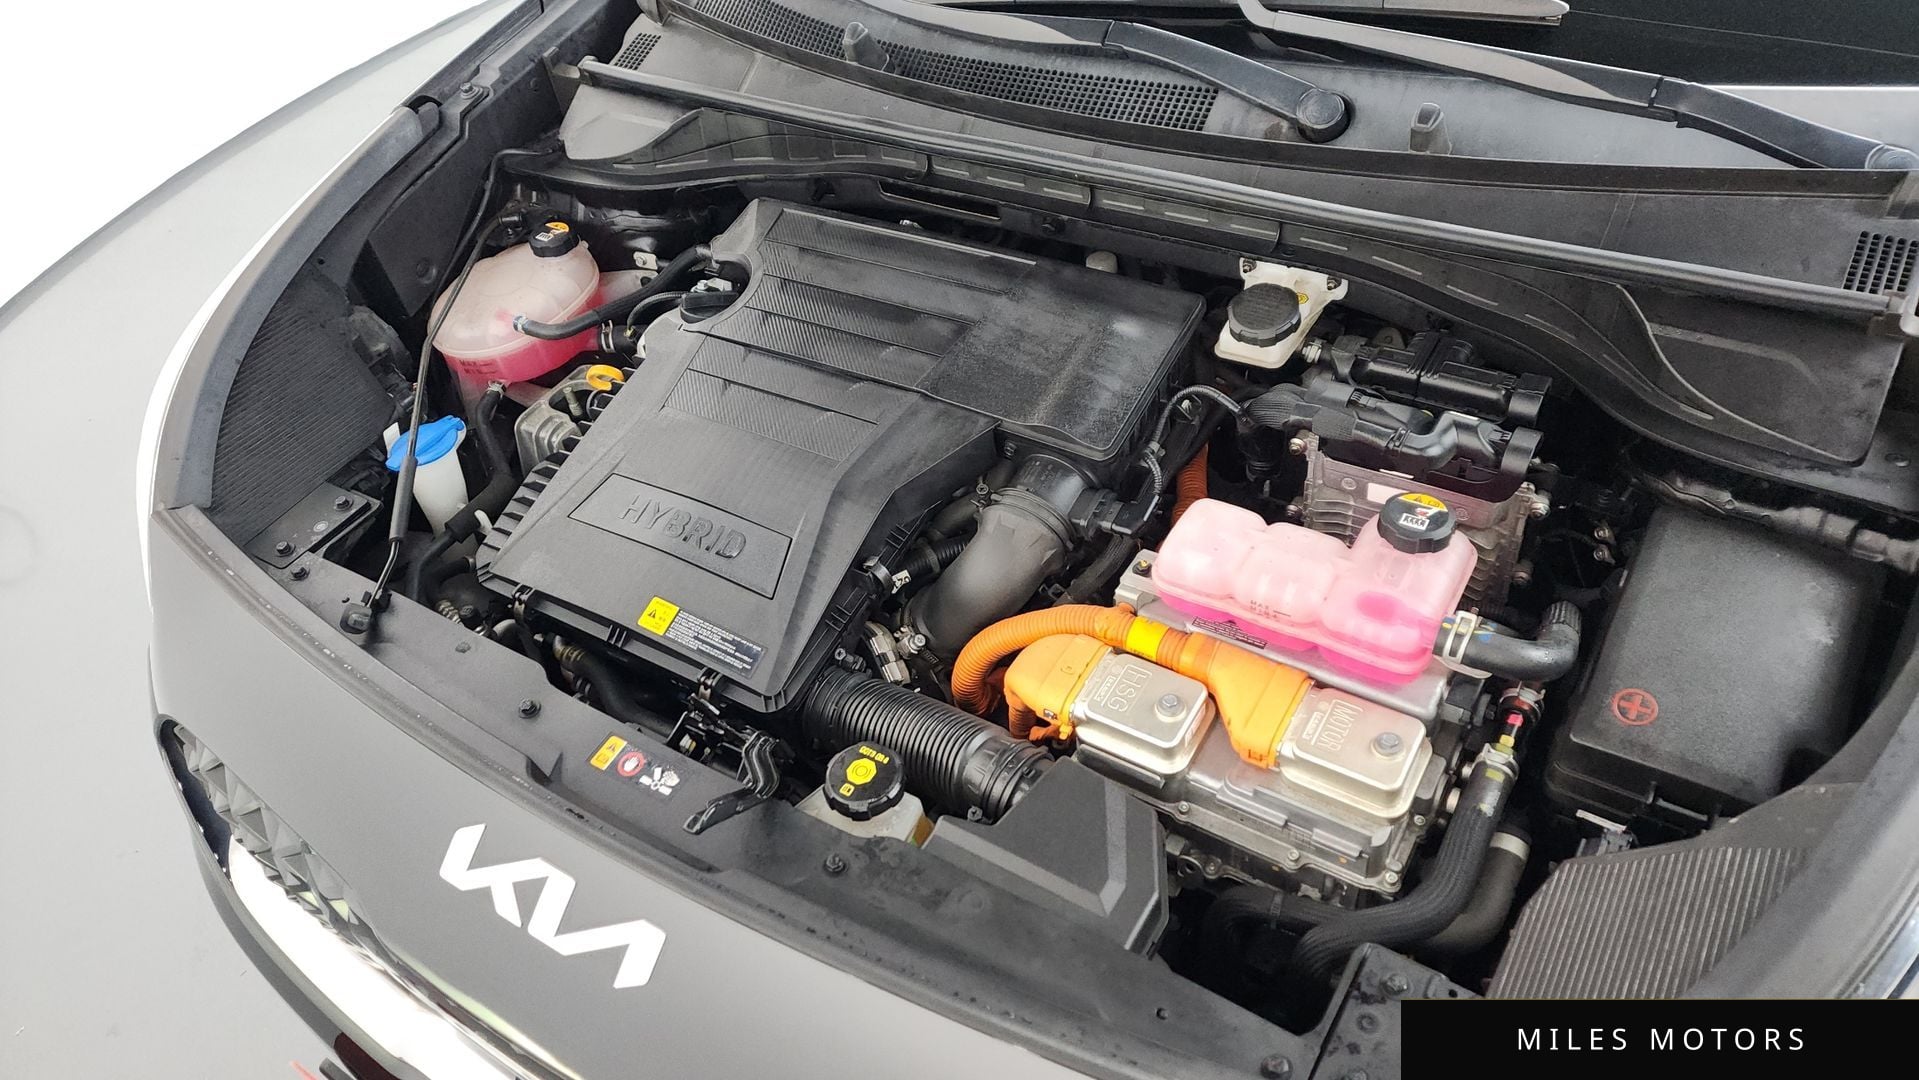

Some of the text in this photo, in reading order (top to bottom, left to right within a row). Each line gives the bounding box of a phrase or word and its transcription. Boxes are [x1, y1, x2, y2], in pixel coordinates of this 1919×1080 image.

[617, 494, 747, 559] HYBRID
[1107, 669, 1148, 713] HSG
[1316, 702, 1359, 752] MOTOR
[439, 823, 667, 989] KIA
